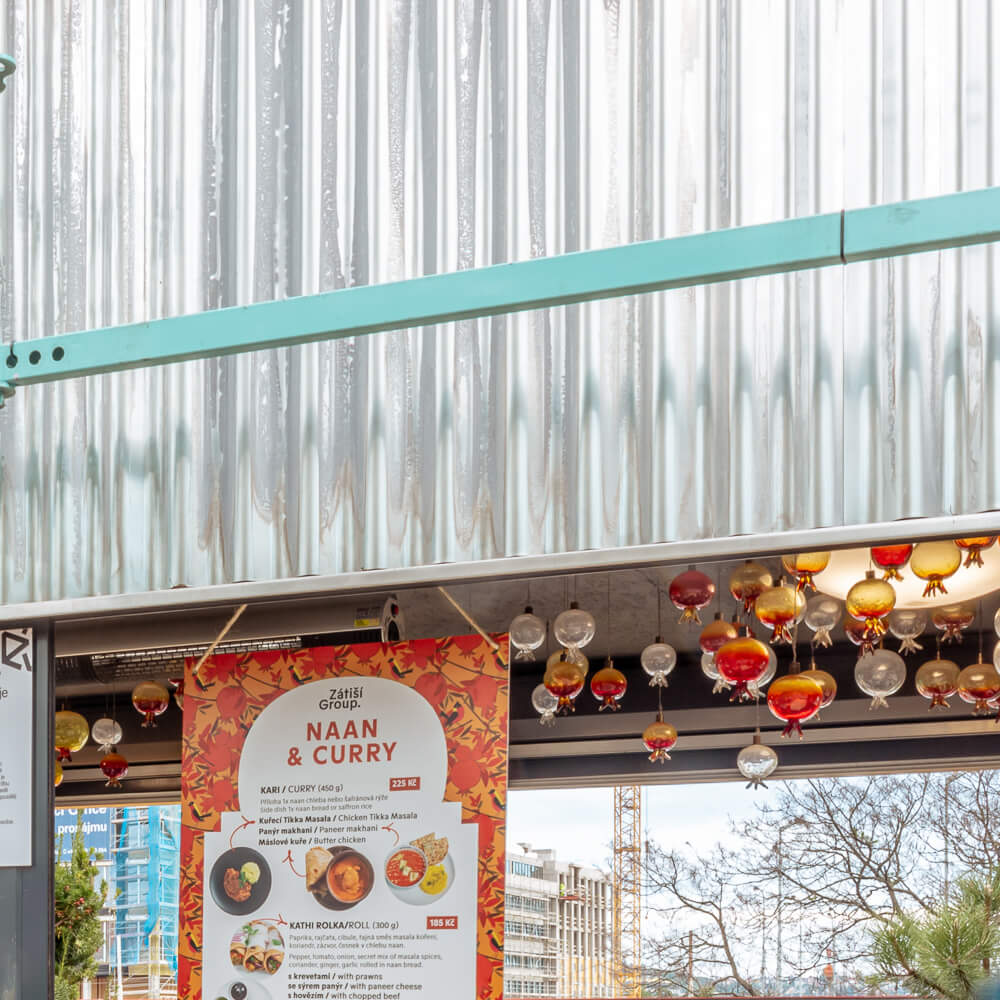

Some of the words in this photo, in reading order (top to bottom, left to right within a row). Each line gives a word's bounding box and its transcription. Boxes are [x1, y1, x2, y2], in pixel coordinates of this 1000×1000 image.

[330, 687, 363, 700] Zátiší
[319, 700, 360, 710] Group.
[307, 719, 378, 741] NAAN
[288, 747, 302, 766] &
[312, 742, 397, 765] CURRY
[261, 786, 280, 794] KARI
[288, 784, 316, 793] CURRY
[318, 784, 333, 793] (450
[335, 784, 344, 793] g)
[259, 815, 282, 824] Kuřecí
[284, 815, 303, 823] Tikka
[305, 815, 331, 823] Masala
[259, 828, 279, 837] Panýr
[281, 826, 312, 834] makhani
[320, 826, 344, 834] Paneer
[346, 824, 378, 832] makhani
[259, 838, 288, 846] Máslové
[290, 837, 307, 845] kuře
[314, 836, 336, 844] Butter
[338, 836, 366, 844] chicken
[290, 921, 314, 929] KATHI
[316, 921, 369, 929] ROLKA/ROLL
[373, 921, 389, 929] (300
[391, 921, 399, 930] g)
